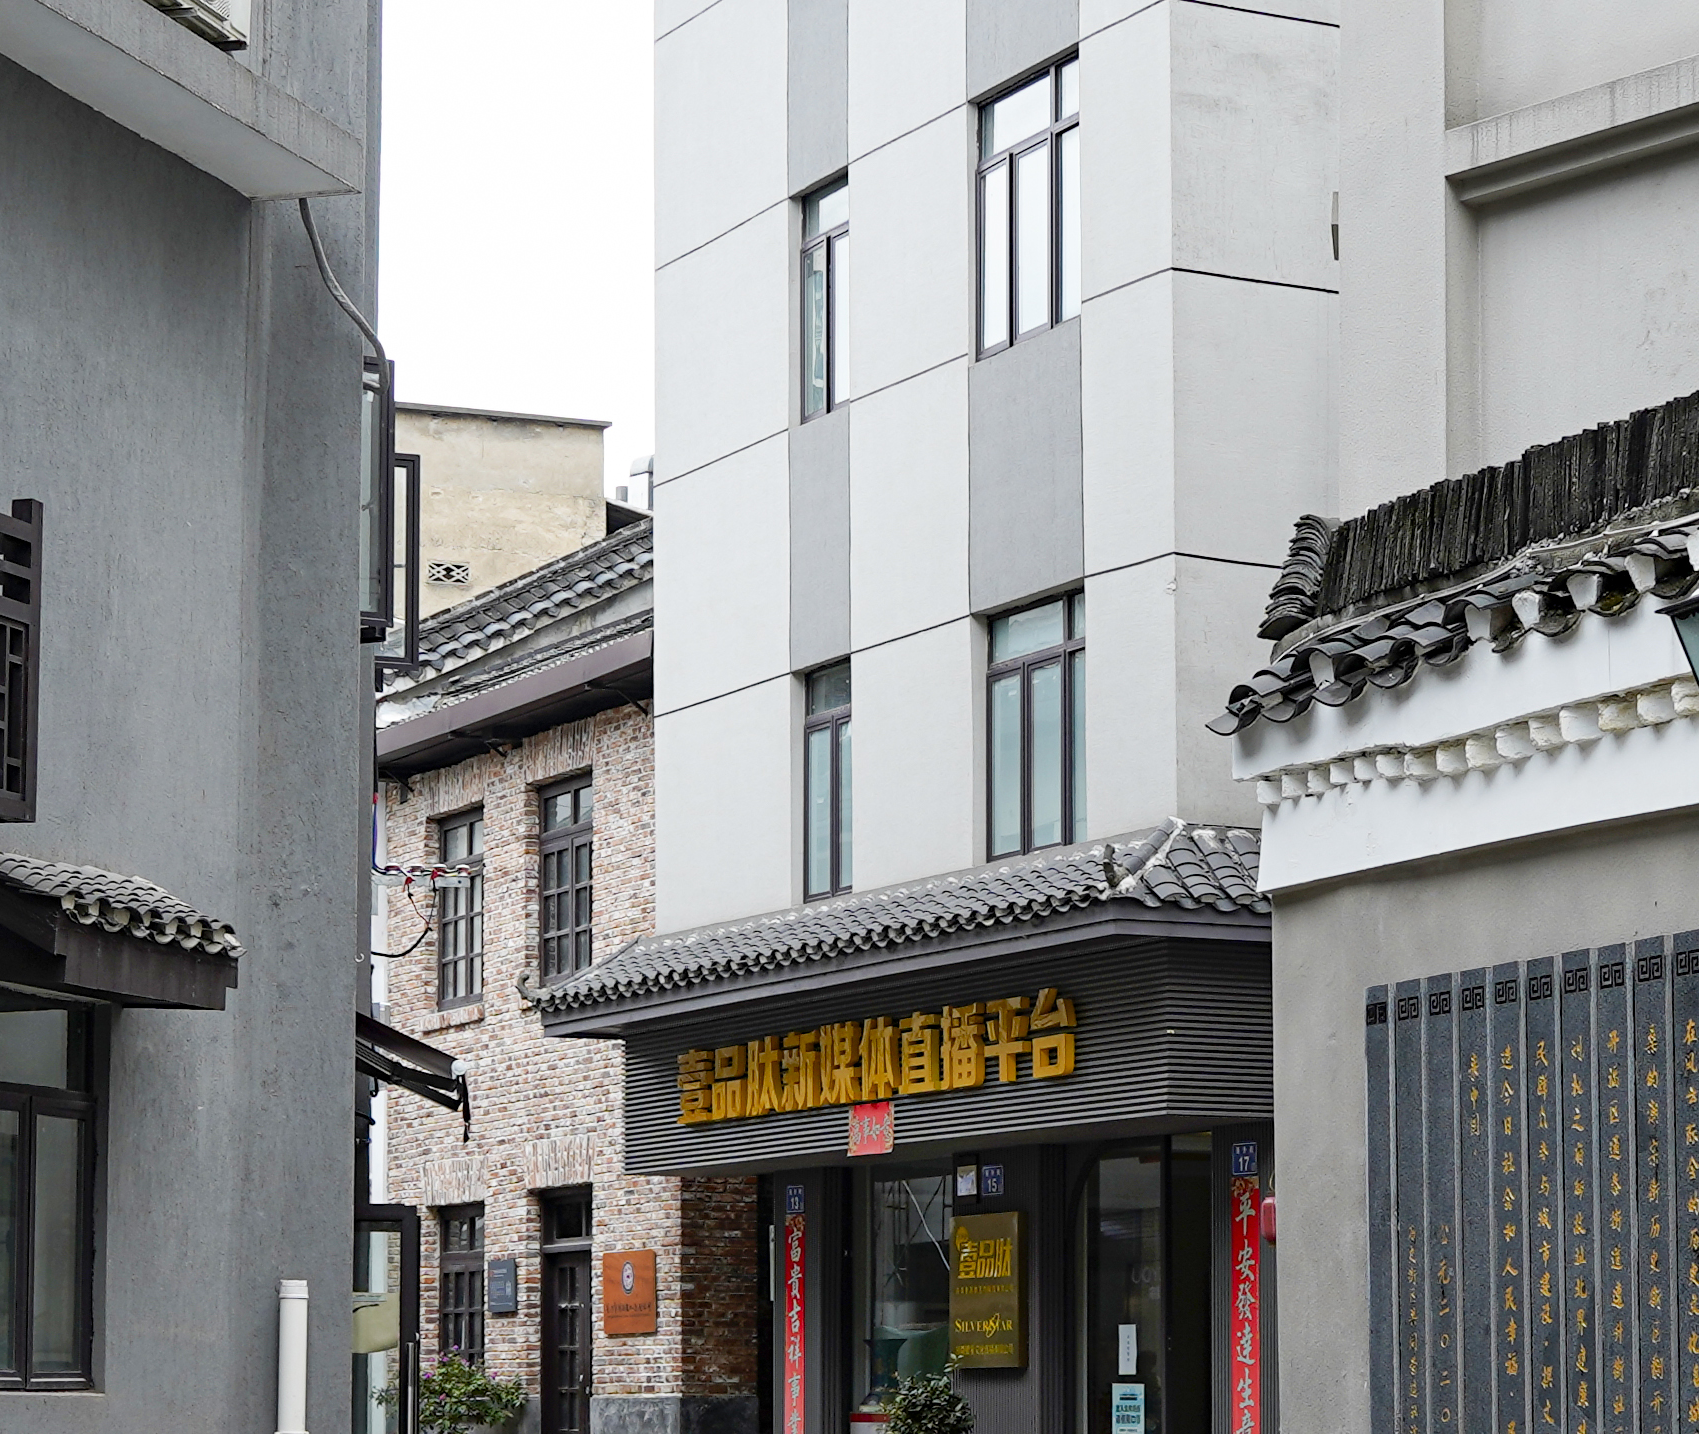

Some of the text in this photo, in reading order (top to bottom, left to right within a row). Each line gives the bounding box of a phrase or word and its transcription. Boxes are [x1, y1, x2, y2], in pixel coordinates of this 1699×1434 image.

[677, 988, 1077, 1125] 壹品肽新媒体直播平台
[1238, 1156, 1250, 1172] 17
[987, 1178, 999, 1193] 15
[790, 1196, 799, 1210] 13
[957, 1238, 1013, 1279] 壹品肽
